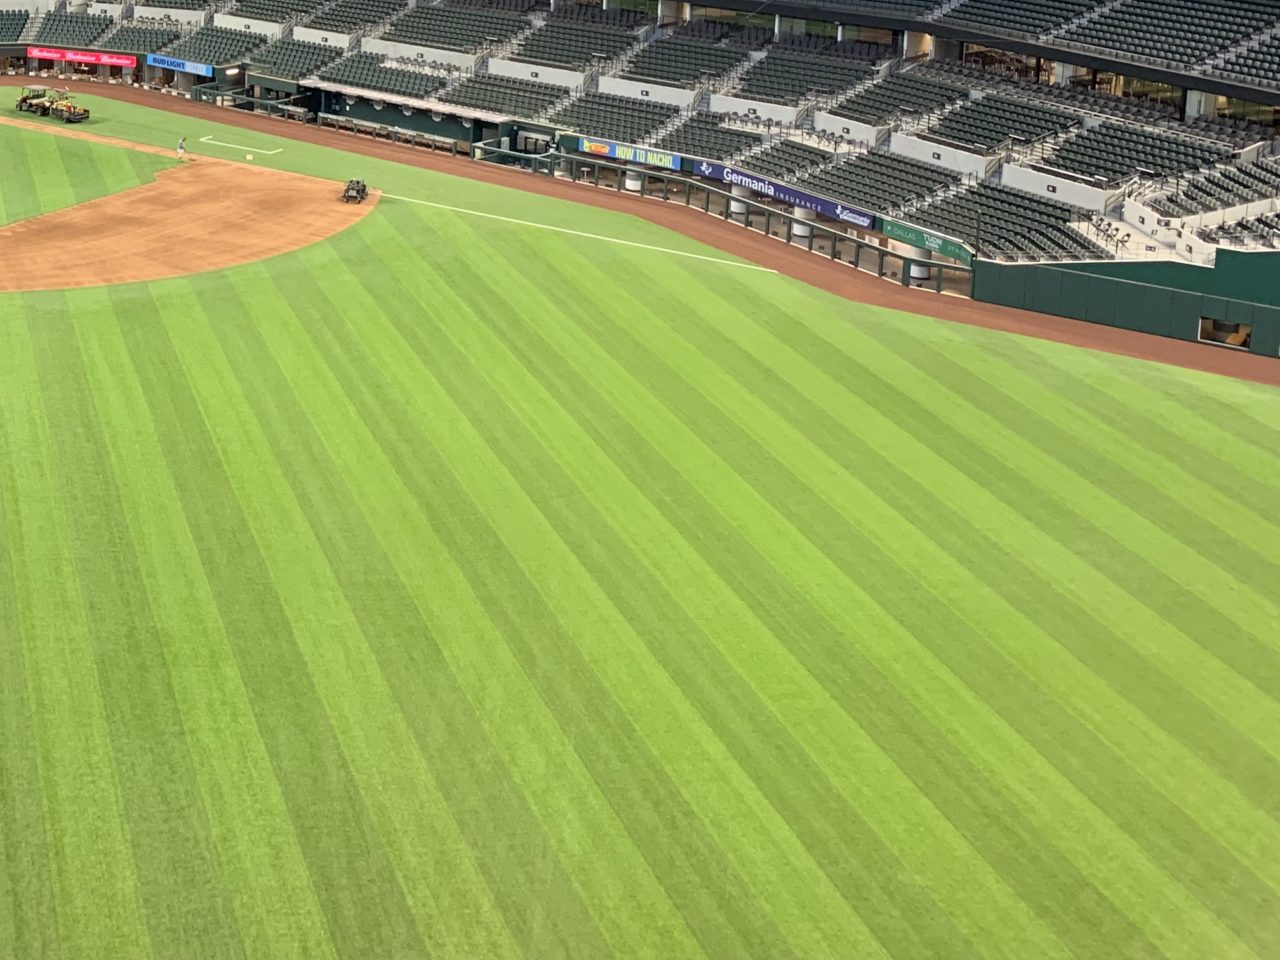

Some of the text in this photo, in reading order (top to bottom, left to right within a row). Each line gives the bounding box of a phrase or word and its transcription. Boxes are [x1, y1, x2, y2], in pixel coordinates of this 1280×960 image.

[153, 57, 166, 65] BUD
[166, 59, 186, 70] LIGHT
[615, 145, 634, 160] HOW
[636, 148, 646, 162] TO
[723, 167, 822, 212] Germania INSURANCE
[893, 228, 916, 240] DALLAS
